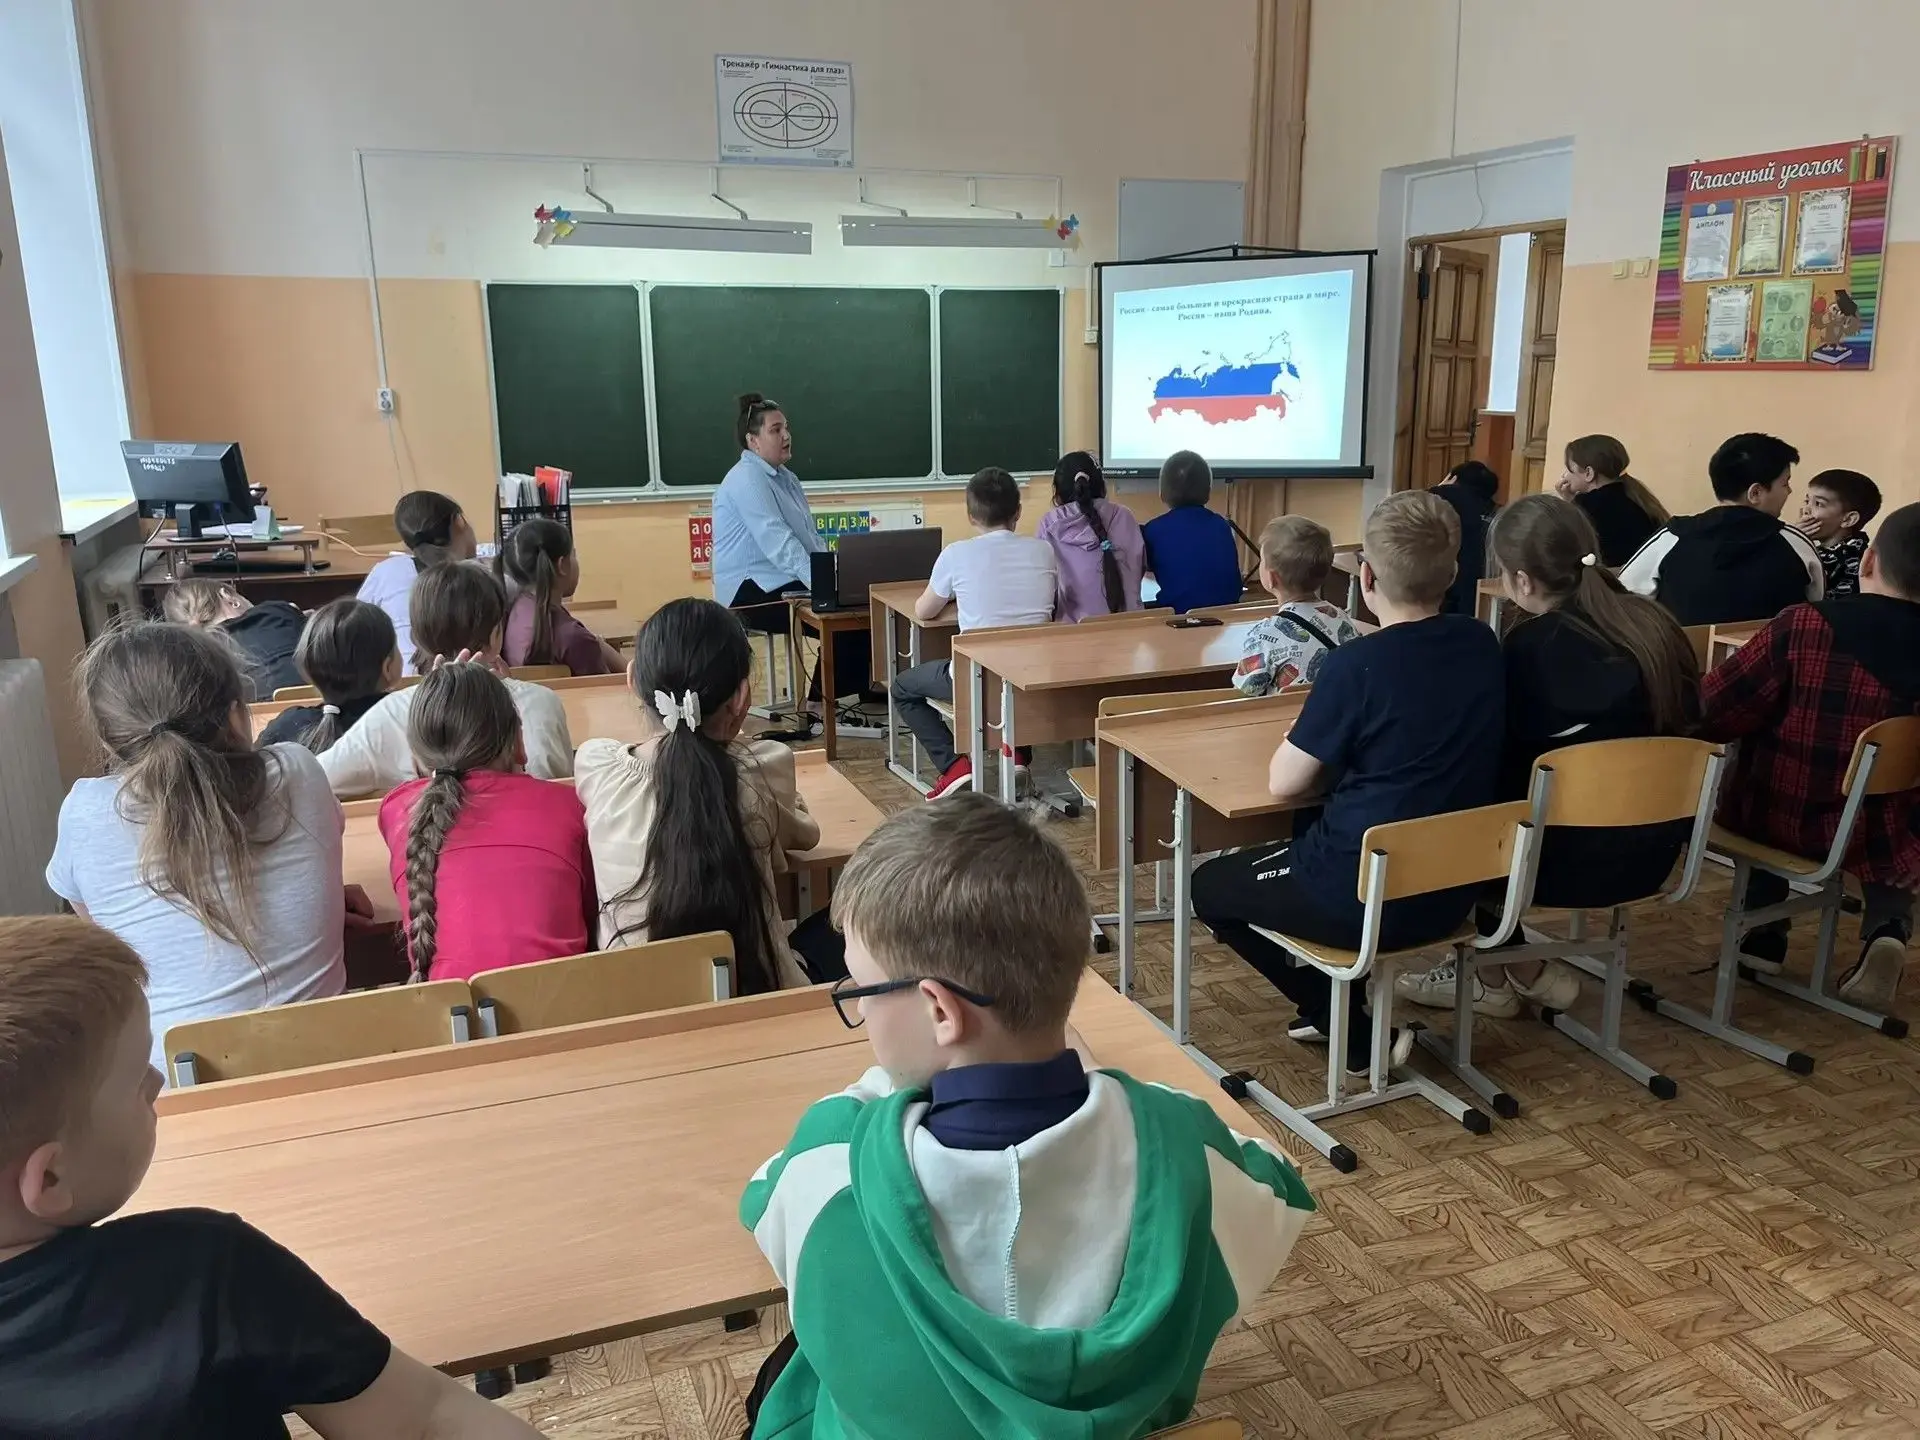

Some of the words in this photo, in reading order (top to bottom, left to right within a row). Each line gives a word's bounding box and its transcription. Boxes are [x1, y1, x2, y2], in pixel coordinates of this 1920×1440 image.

[721, 59, 760, 70] Тренажёр
[810, 66, 825, 74] для
[826, 67, 845, 75] глаз»
[1690, 161, 1775, 191] Классный
[1777, 157, 1844, 190] уголок
[1695, 219, 1725, 229] ДИПЛОМ
[1176, 301, 1212, 310] большая
[1221, 295, 1271, 308] прекрасная
[1273, 293, 1304, 303] страна
